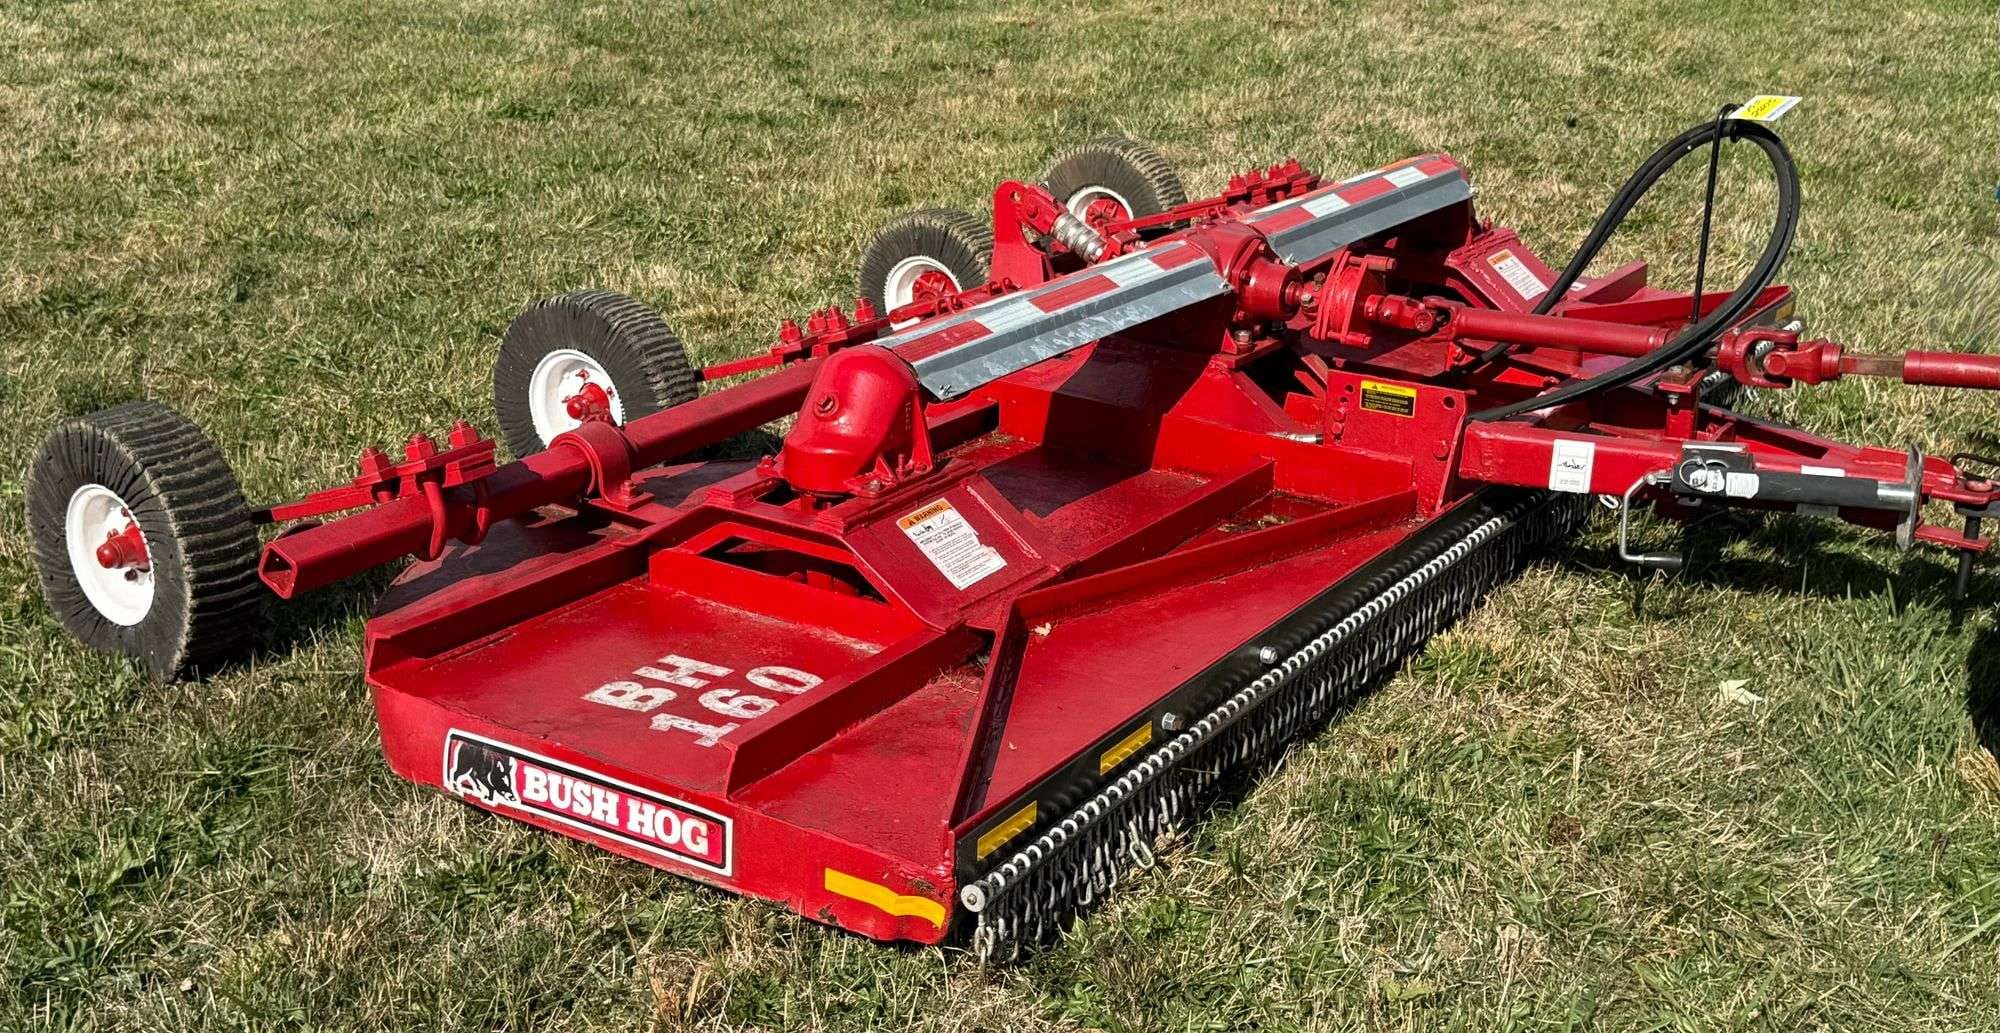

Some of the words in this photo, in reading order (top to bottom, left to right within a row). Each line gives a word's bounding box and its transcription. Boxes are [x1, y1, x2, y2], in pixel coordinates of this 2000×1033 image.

[914, 504, 944, 522] WARNING
[581, 654, 734, 712] BH
[648, 665, 825, 748] 160
[522, 765, 619, 827] BUSH
[627, 797, 709, 856] HOG
